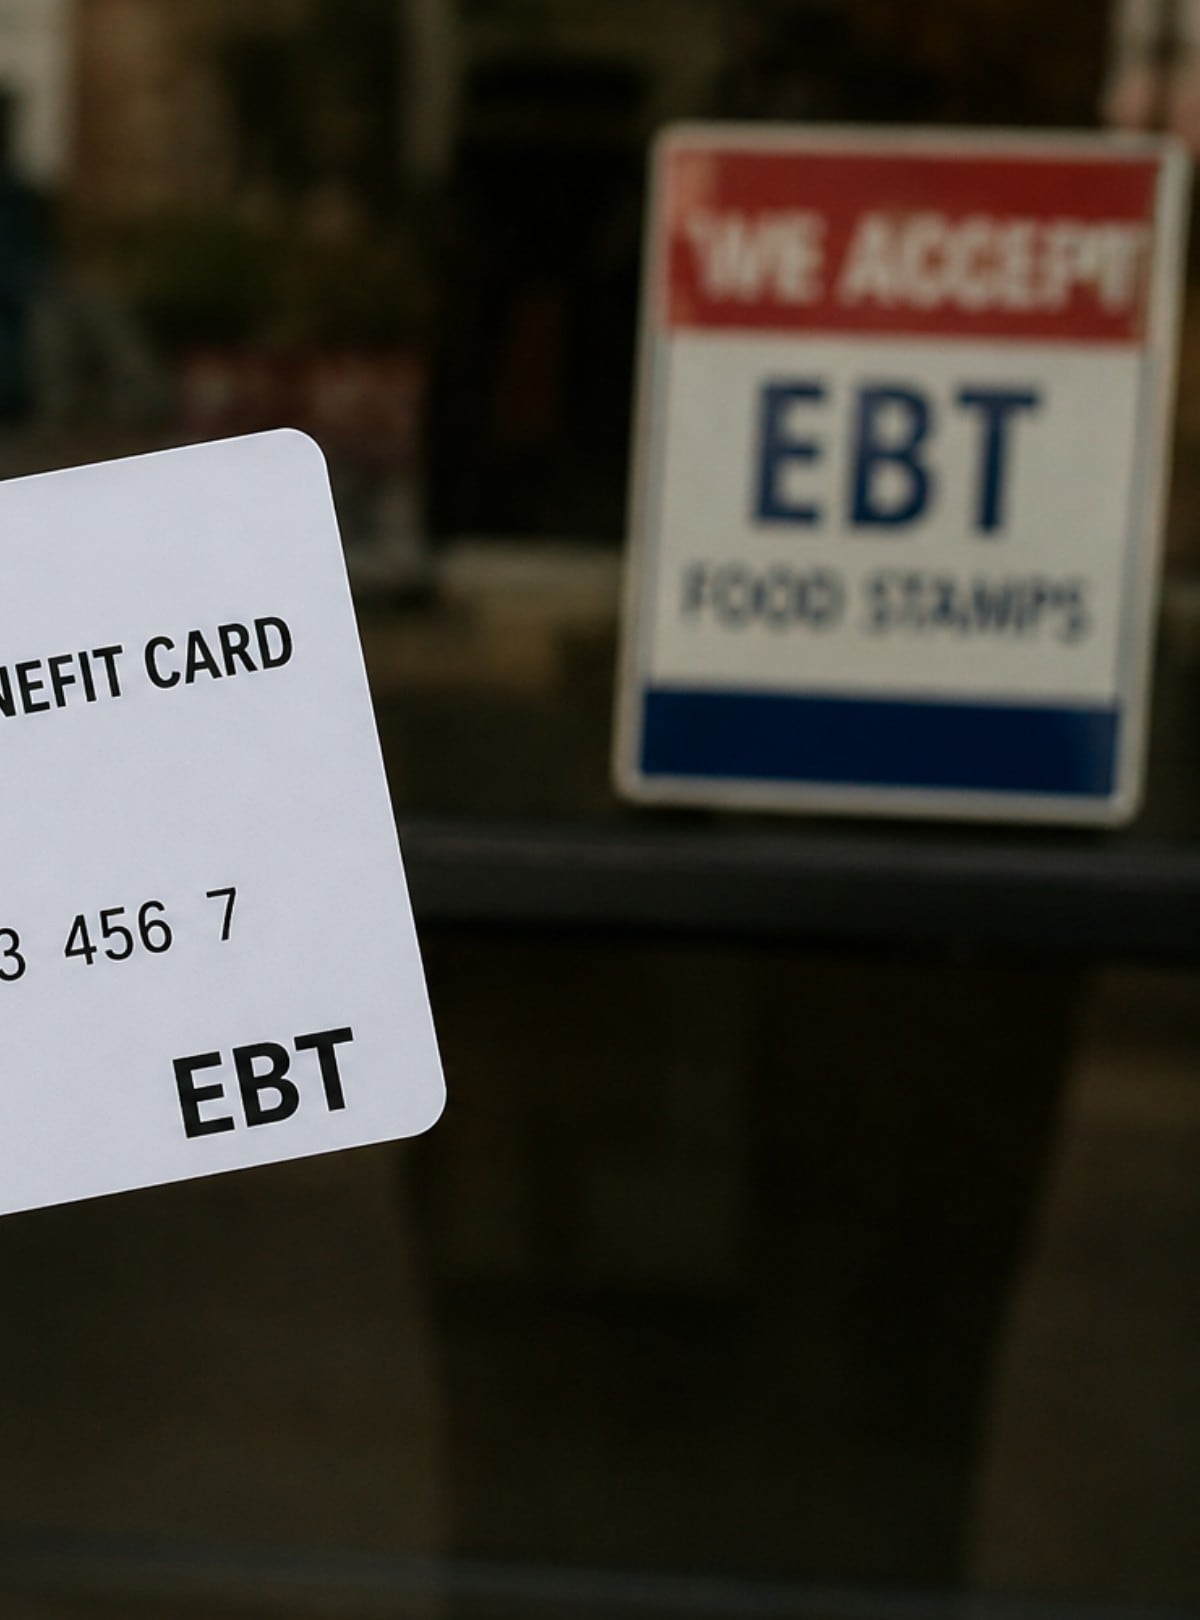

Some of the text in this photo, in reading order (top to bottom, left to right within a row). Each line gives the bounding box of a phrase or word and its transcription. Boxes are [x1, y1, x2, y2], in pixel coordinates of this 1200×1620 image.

[682, 209, 1147, 315] WE ACCEPT
[751, 378, 1045, 538] EBT
[683, 562, 1091, 645] FOOD STAMPS
[144, 616, 293, 689] CARD
[63, 900, 173, 966] 456
[205, 886, 237, 942] 7
[171, 1026, 354, 1138] EBT
